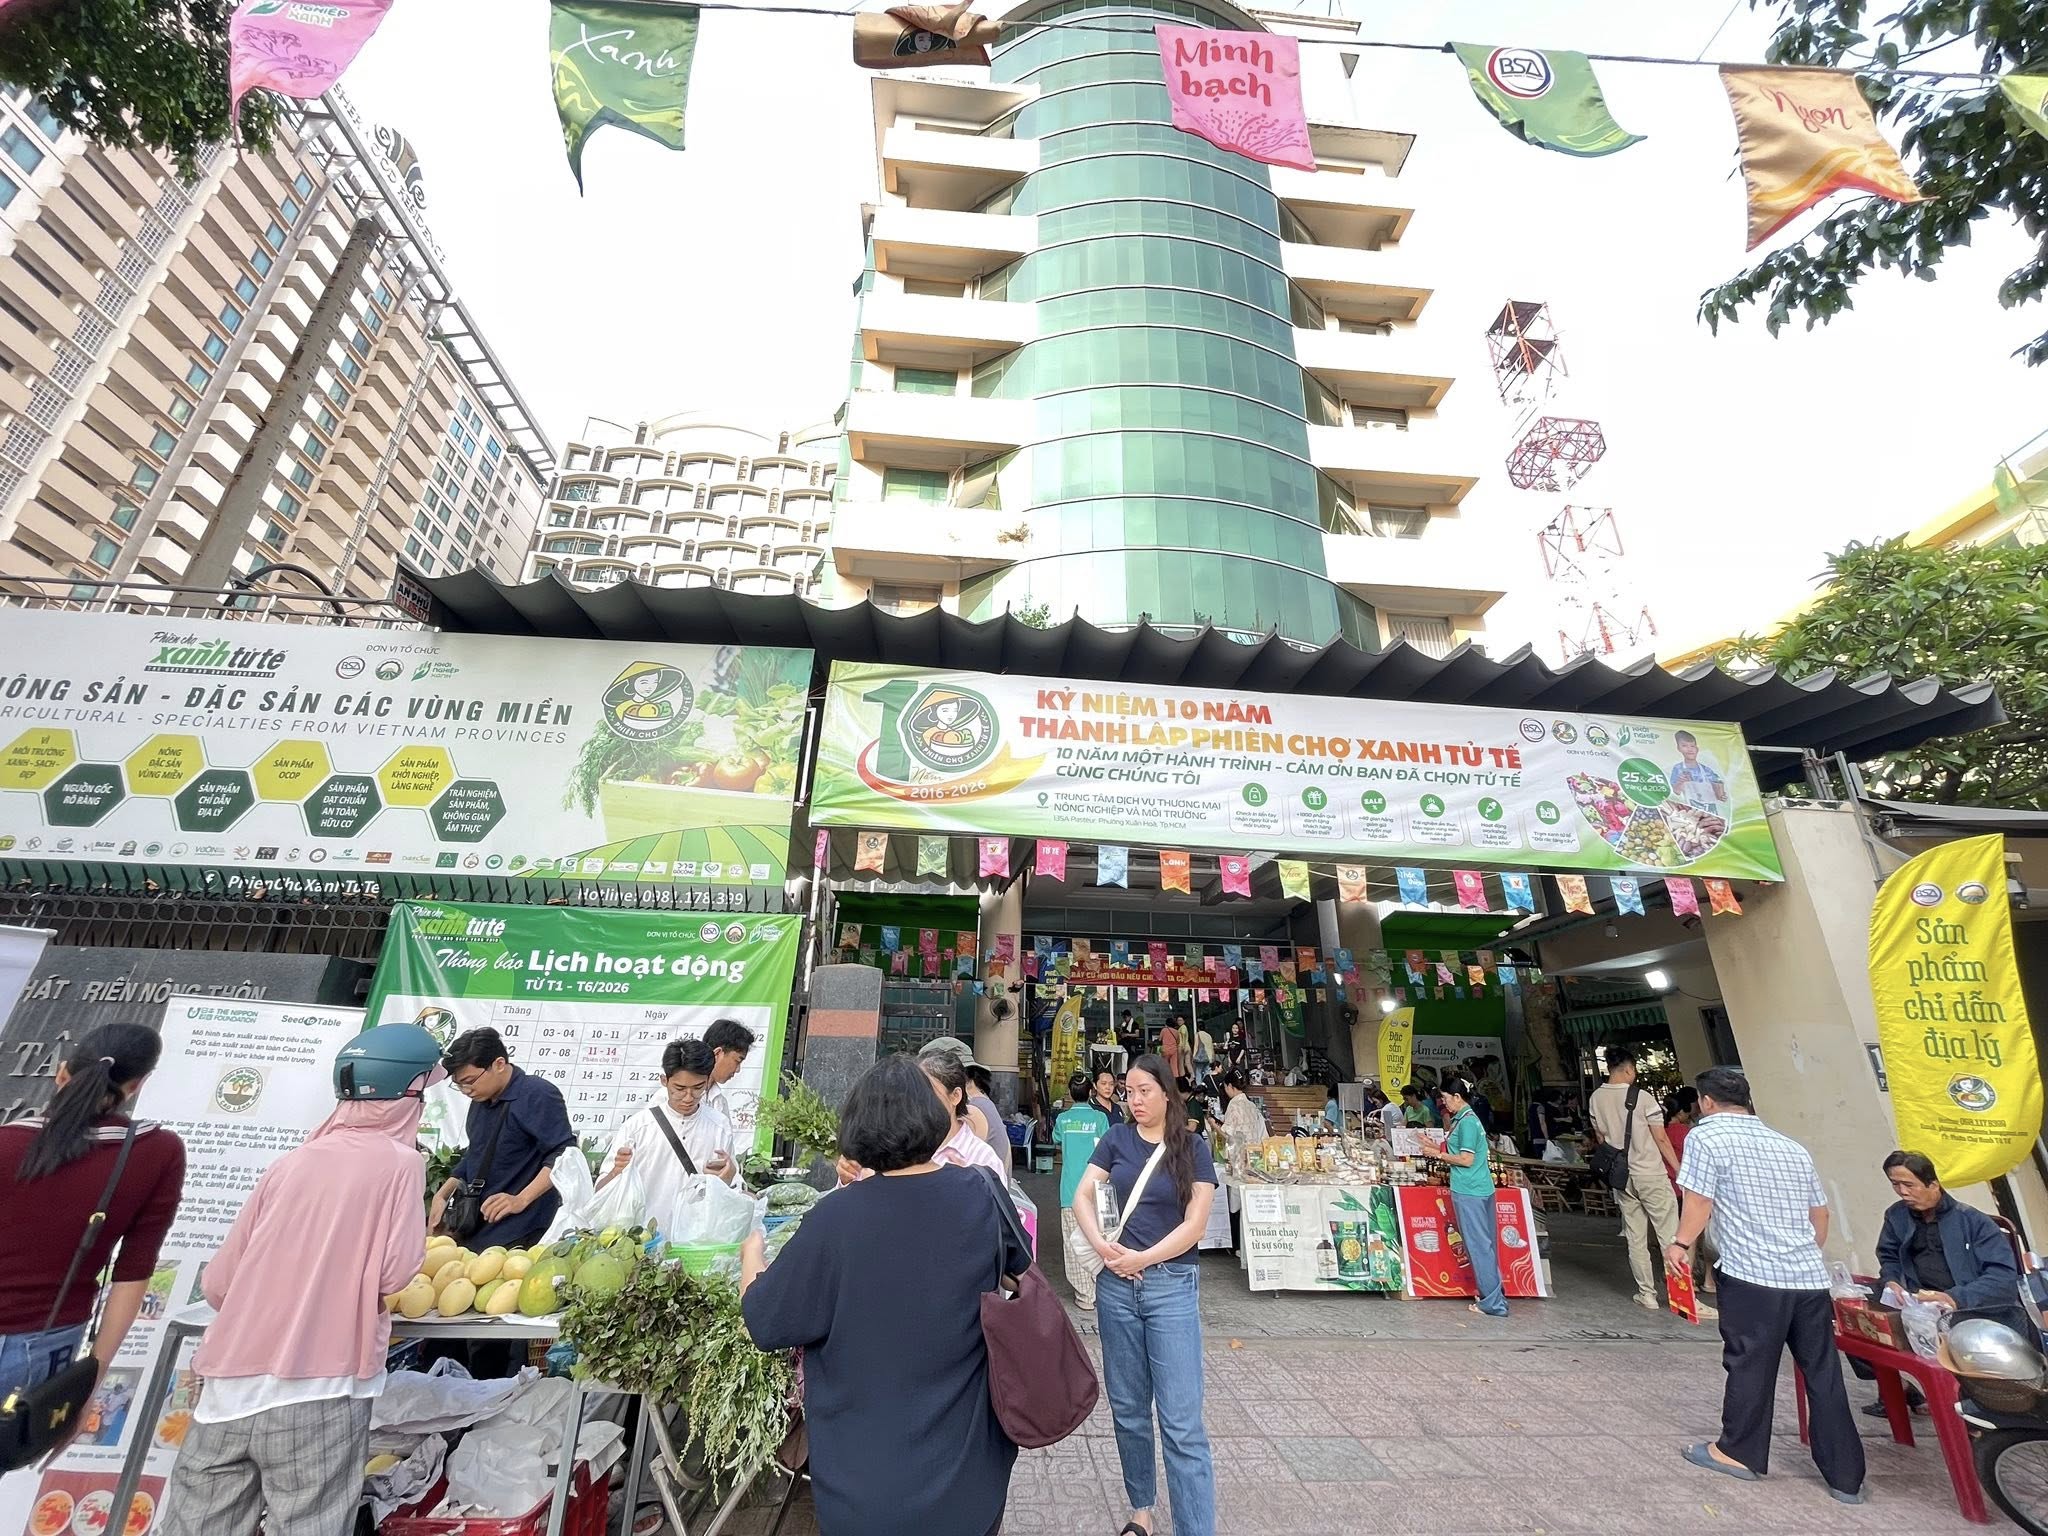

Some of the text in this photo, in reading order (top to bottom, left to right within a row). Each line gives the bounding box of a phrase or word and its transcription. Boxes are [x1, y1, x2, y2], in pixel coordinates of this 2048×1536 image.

[288, 10, 332, 26] XANH
[552, 23, 682, 78] Xanh
[1174, 37, 1274, 73] Minh
[1499, 57, 1544, 78] BSA
[1180, 72, 1271, 107] bạch
[149, 640, 231, 668] xanh
[83, 676, 148, 705] SẢN
[184, 684, 246, 713] ĐẶC
[259, 685, 322, 714] SẢN
[334, 691, 393, 717] CÁC
[407, 695, 484, 721] VÙNG
[496, 698, 573, 725] MIỀN
[1037, 686, 1273, 725] KỶ NIỆM 10 NĂM
[152, 713, 282, 731] SPECIALTIES
[291, 721, 347, 734] FROM
[357, 723, 446, 738] VIETNAM
[455, 728, 567, 744] PROVINCES
[1019, 716, 1522, 770] THÀNH LẬP PHIÊN CHỢ XANH TỬ TẾ
[1056, 747, 1522, 788] 10 NĂM MỘT HÀNH TRÌNH CẢM ƠN BẠN ĐÃ CHỌN TỬ TẾ
[1056, 762, 1201, 786] CÙNG CHÚNG TÔI
[449, 788, 497, 800] TRẢI NGHIỆM
[910, 781, 987, 799] 2016-2026
[1055, 792, 1221, 811] TRUNG TÂM DỊCH VỤ THƯƠNG MẠI
[443, 810, 490, 822] KHÔNG GIAN
[1054, 802, 1207, 820] NÔNG NGHIỆP VÀ MÔI TRƯỜNG
[1916, 917, 1968, 945] Sản
[436, 949, 747, 984] Thông báo Lịch hoạt động
[1906, 950, 1989, 987] phẩm
[138, 977, 202, 1003] NÔNG
[208, 980, 267, 1000] THÔN
[525, 977, 630, 993] TỪ T1 T6/2026
[213, 1016, 257, 1024] FOUNDATION
[502, 1006, 668, 1021] Tháng Ngày
[1903, 990, 2006, 1023] chỉ dẫn
[1923, 1027, 2002, 1068] địa lý
[1252, 1239, 1294, 1252] từ sự sống
[1279, 1228, 1299, 1239] chay
